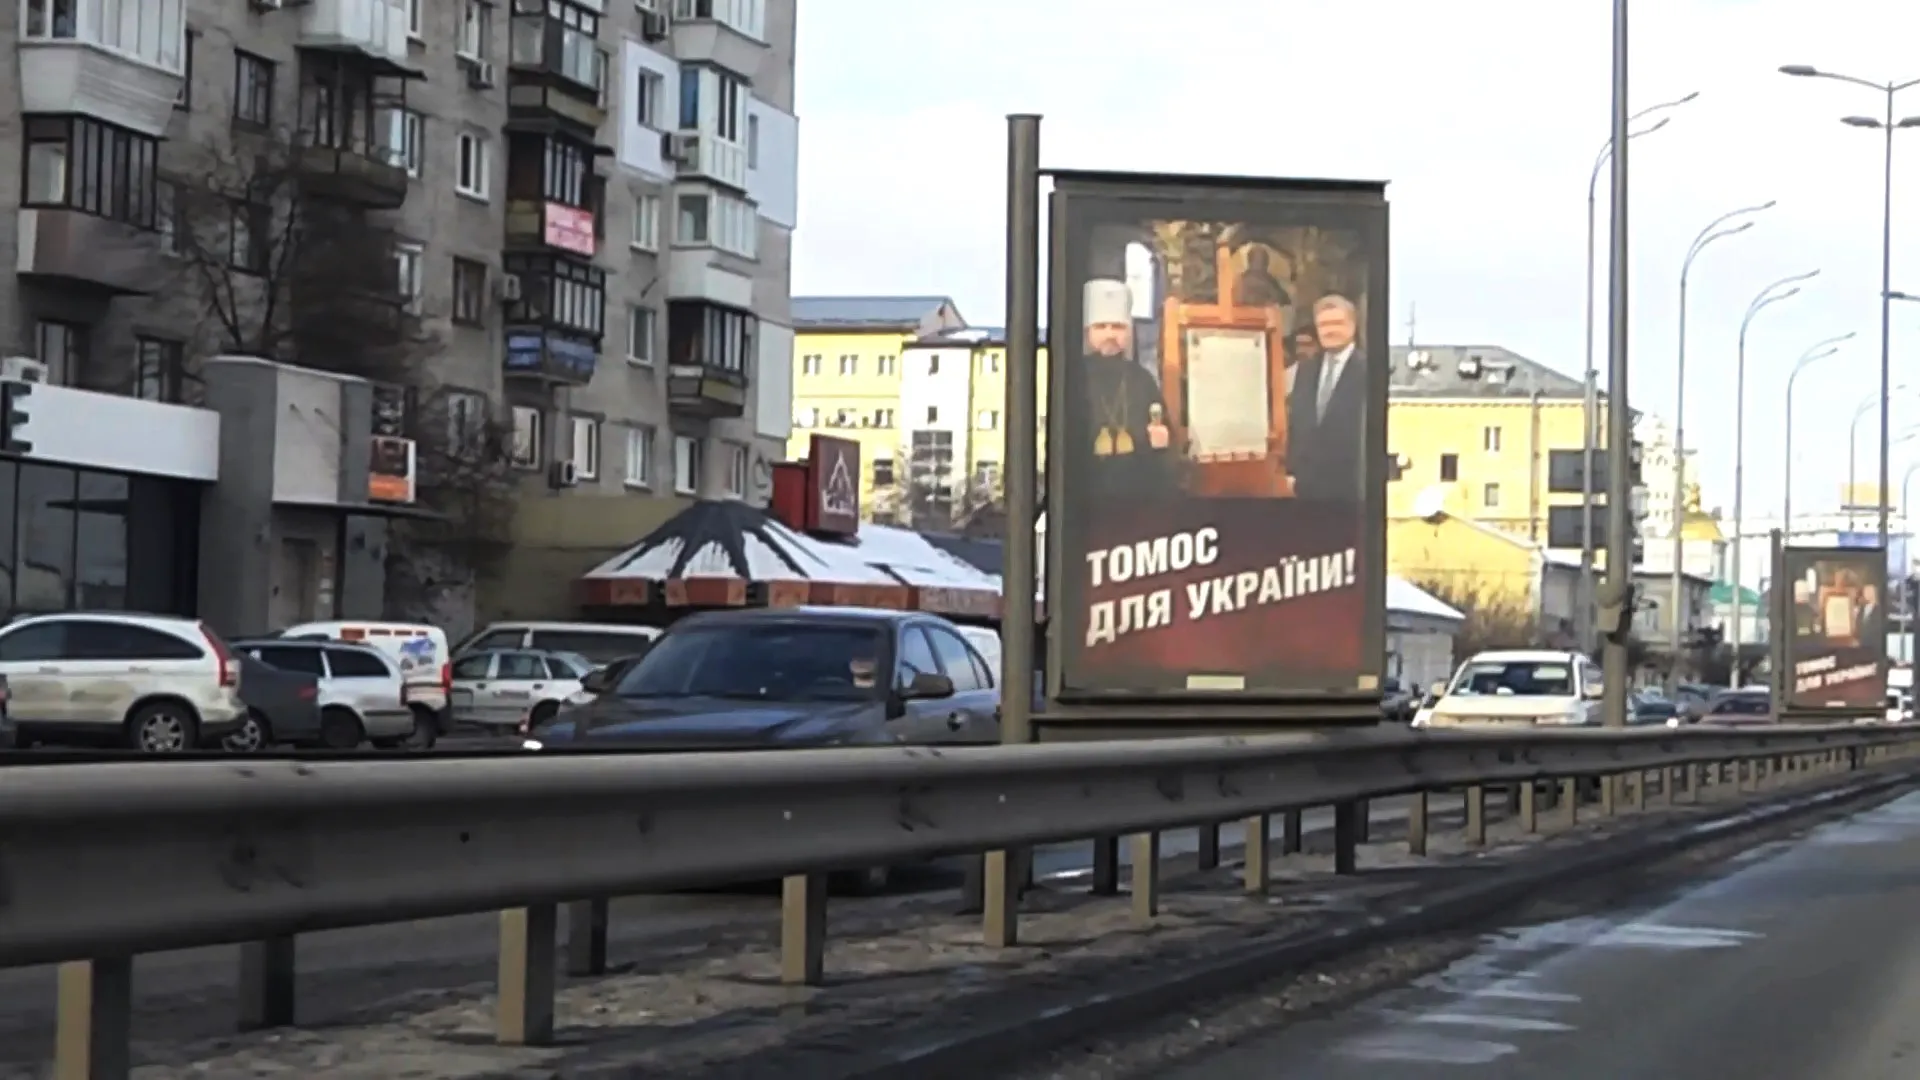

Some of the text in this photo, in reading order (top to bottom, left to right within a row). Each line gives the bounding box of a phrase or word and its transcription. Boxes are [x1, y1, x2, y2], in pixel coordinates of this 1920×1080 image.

[1086, 527, 1219, 587] ТОМОС
[1085, 548, 1357, 647] ДЛЯ УКРАЇНИ!
